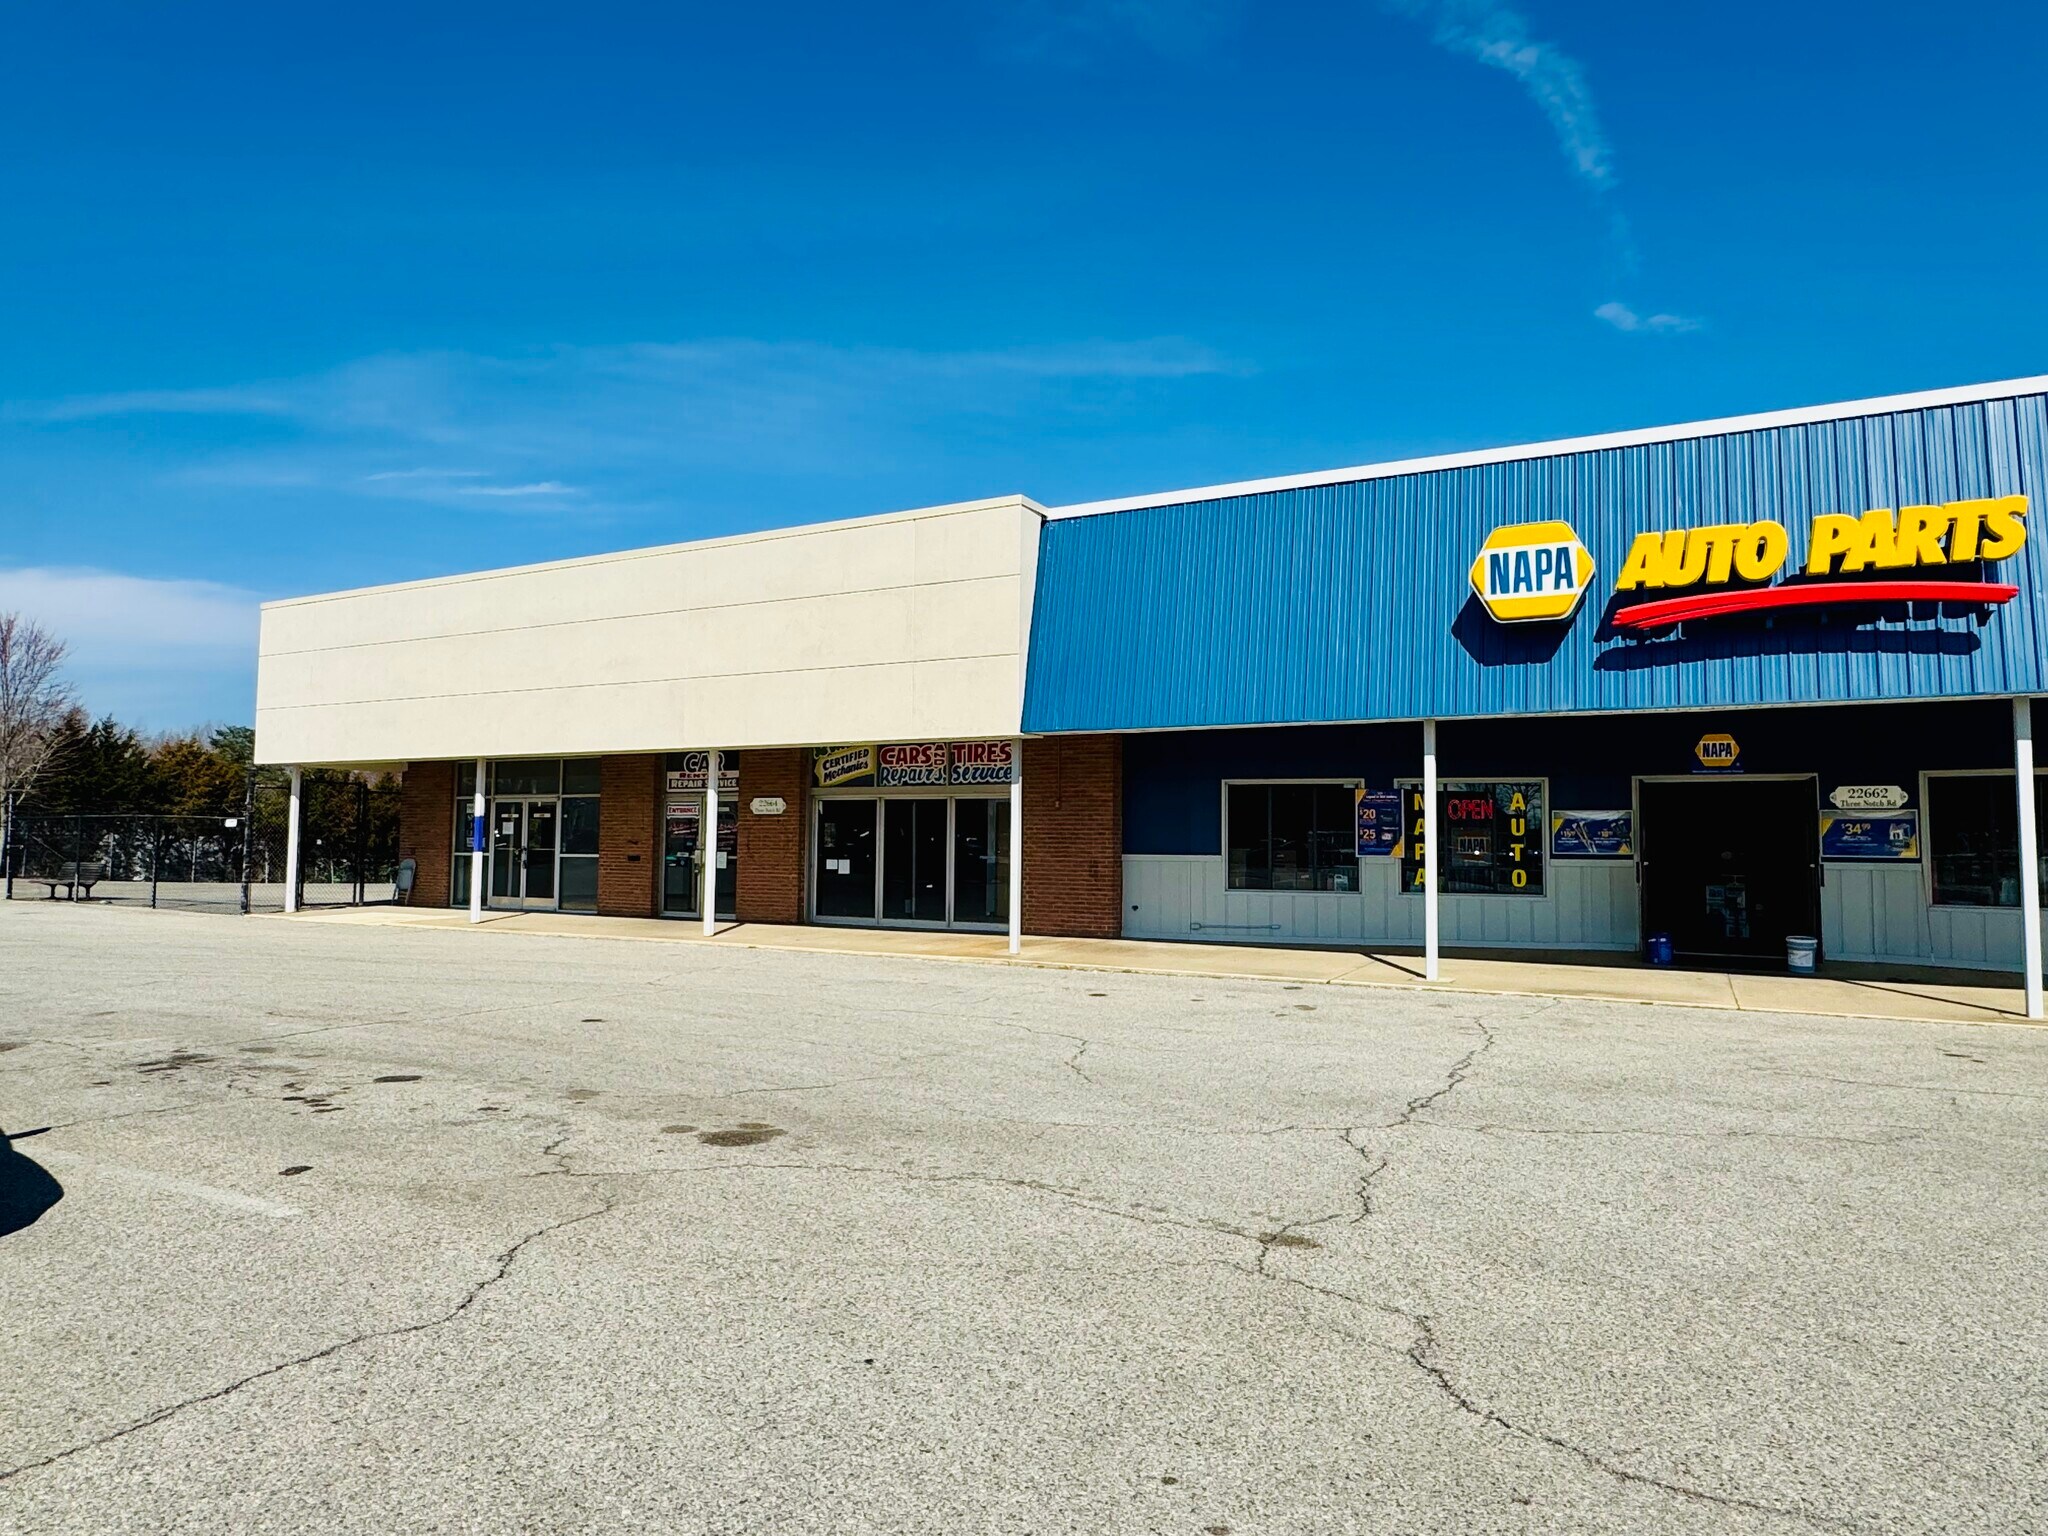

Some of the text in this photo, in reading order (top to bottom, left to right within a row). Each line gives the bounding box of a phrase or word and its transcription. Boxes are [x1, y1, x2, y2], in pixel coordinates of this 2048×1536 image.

[1615, 494, 2029, 592] AUTO PARTS
[1489, 546, 1576, 595] NAPA
[822, 748, 869, 771] CERTIFIED
[880, 745, 933, 766] CARS
[951, 741, 1012, 764] TIRES
[1702, 742, 1733, 758] NAPA
[823, 760, 869, 783] Mechanics
[951, 764, 1012, 783] Service
[671, 778, 737, 788] REPAIR SVICE
[1847, 787, 1889, 799] 22662
[1360, 808, 1376, 819] $20
[1447, 799, 1494, 820] OPEN
[1360, 829, 1376, 839] $25
[1510, 792, 1527, 888] AUTO
